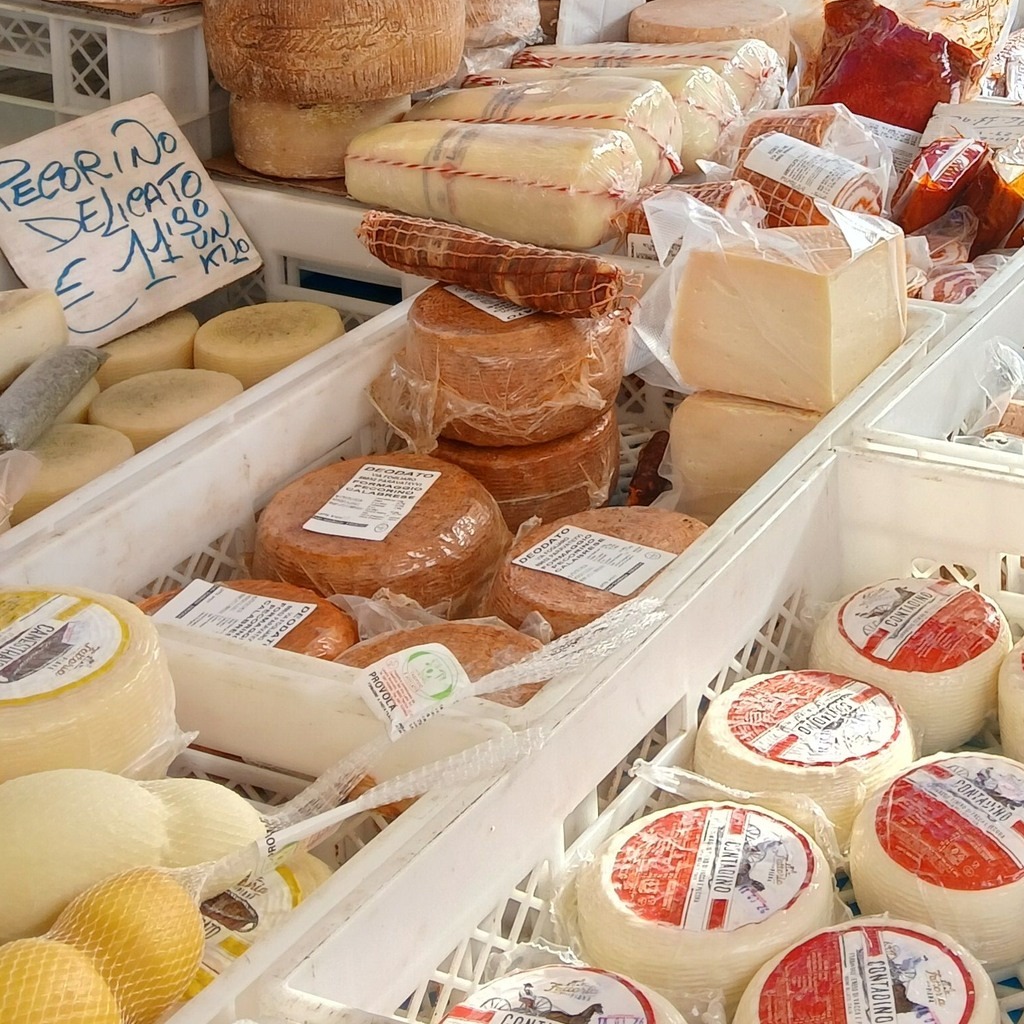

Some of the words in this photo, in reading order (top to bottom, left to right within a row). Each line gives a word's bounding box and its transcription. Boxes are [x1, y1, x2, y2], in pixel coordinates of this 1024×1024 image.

[0, 119, 177, 212] PECORINO
[19, 161, 202, 253] DELICATO
[191, 209, 230, 249] UN
[199, 237, 250, 274] KILO
[352, 479, 423, 492] FORMAGGIO
[353, 484, 414, 495] PECORINO
[364, 466, 434, 478] DEODATO
[519, 528, 570, 564] DEODATO
[541, 534, 592, 570] FORMAGGIO
[551, 538, 595, 569] PECORINO
[264, 605, 310, 646] DEODAT
[885, 591, 933, 628] CONTADINO
[369, 671, 398, 712] PROVOLA
[953, 779, 1013, 822] CONTADINO
[713, 840, 742, 894] CONTADINO
[868, 960, 894, 1024] CONTADINO
